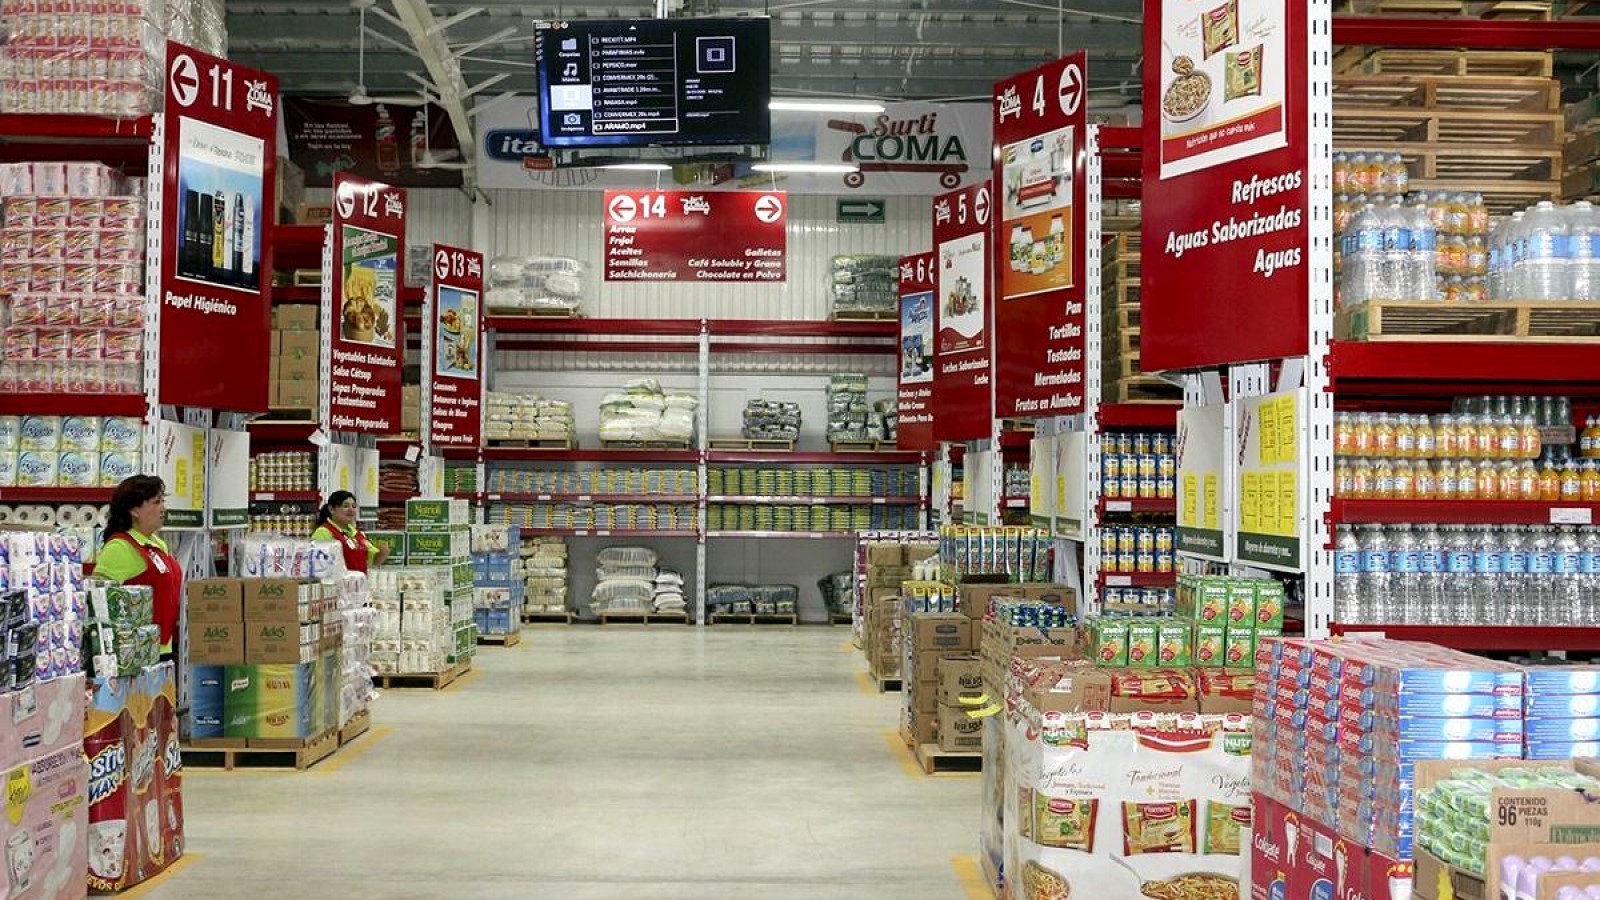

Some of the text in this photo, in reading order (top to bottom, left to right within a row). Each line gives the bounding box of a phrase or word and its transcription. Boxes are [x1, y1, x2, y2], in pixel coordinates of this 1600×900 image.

[208, 64, 233, 111] 11
[1032, 75, 1045, 117] 4
[873, 112, 937, 137] Surti
[853, 135, 967, 161] COMA
[1232, 170, 1302, 204] Refrescos
[363, 184, 378, 218] 12
[639, 195, 666, 218] 14
[958, 194, 966, 224] 5
[1165, 205, 1301, 258] Aguas Saborizadas
[609, 248, 643, 256] Aceites
[745, 248, 782, 257] Galletas
[452, 252, 464, 276] 13
[609, 258, 648, 267] Semillas
[688, 258, 782, 270] Café Soluble y Grano
[916, 258, 924, 282] 6
[1254, 248, 1300, 278] Aguas
[609, 270, 677, 280] Salchichonería
[696, 270, 782, 280] Chocolate en Polvo
[164, 290, 236, 315] Papel Higiénico
[1066, 301, 1082, 315] Pan
[1048, 323, 1081, 340] Tortillas
[1047, 346, 1081, 363] Tostadas
[1034, 368, 1081, 386] Mermeladas
[1016, 398, 1038, 412] Frutas
[1040, 399, 1049, 409] en
[332, 415, 354, 428] Frijoles
[1498, 797, 1546, 806] CONTENIDO
[1498, 806, 1517, 826] 96
[1518, 807, 1548, 816] PIEZAS
